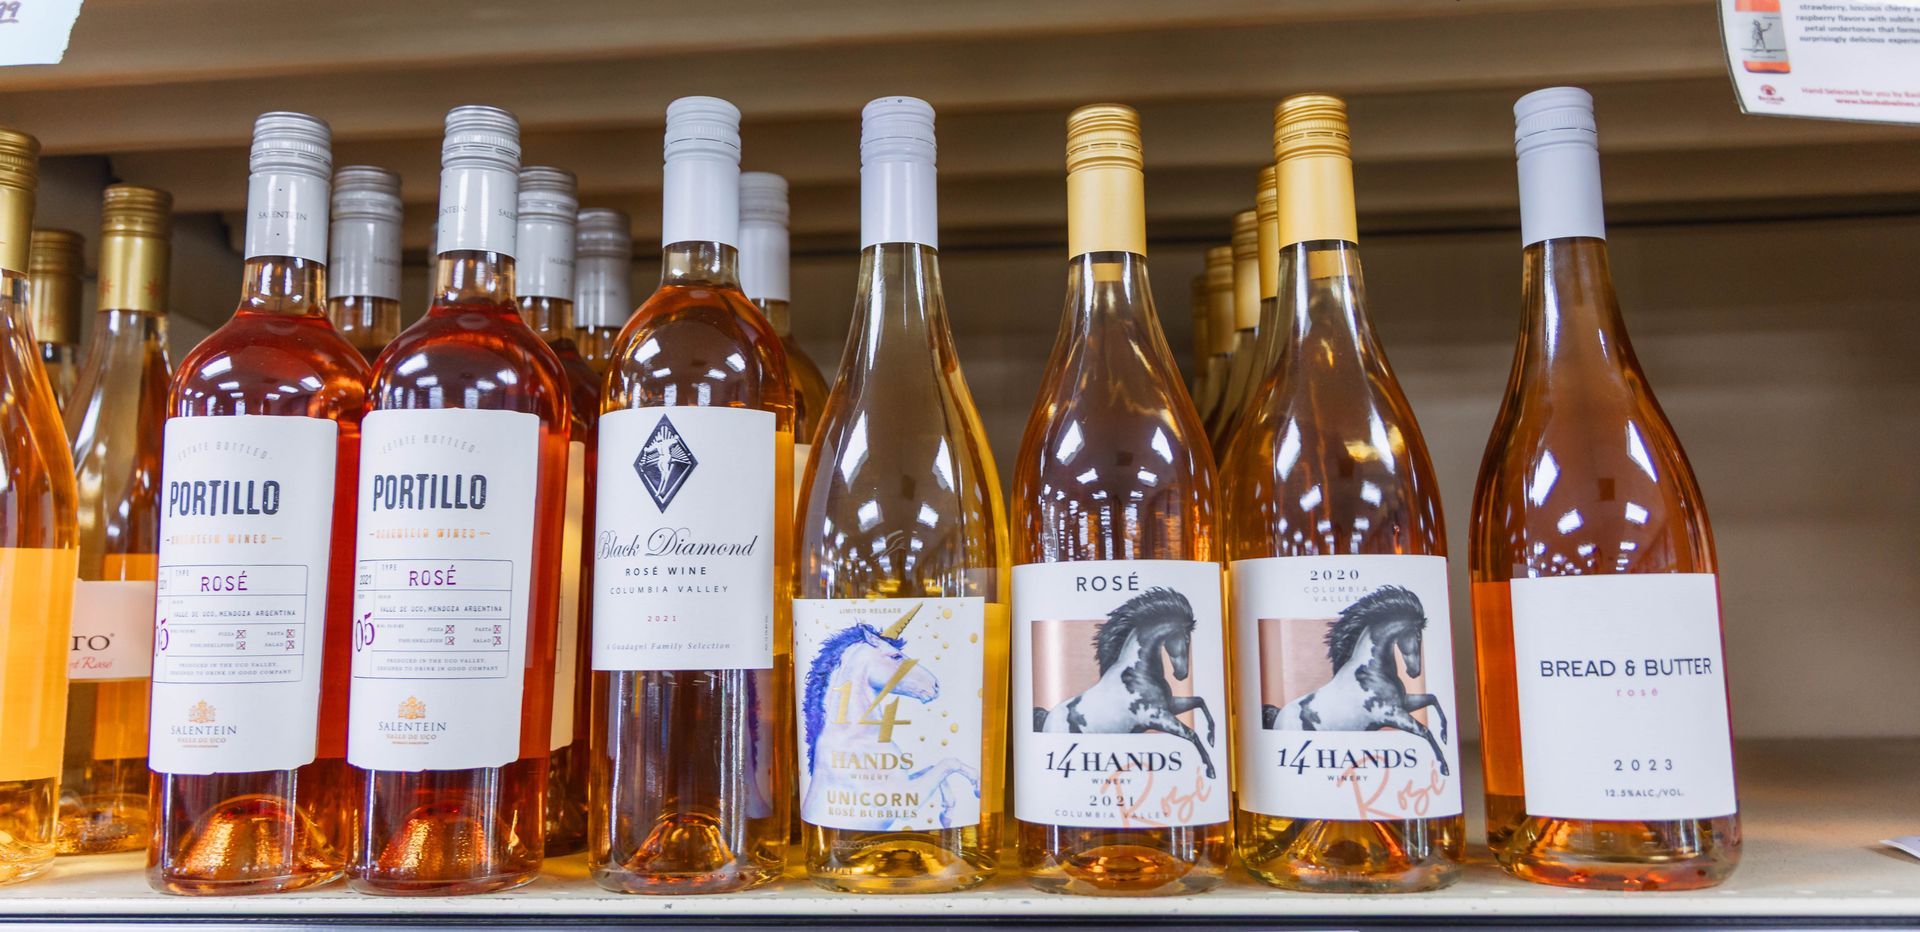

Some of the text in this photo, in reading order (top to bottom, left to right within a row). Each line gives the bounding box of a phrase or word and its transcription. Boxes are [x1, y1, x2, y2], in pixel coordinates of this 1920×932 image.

[372, 473, 488, 512] PORTILLO
[169, 480, 281, 518] PORTILLO
[597, 526, 759, 561] Black Diamond
[408, 564, 457, 586] ROSÉ
[625, 565, 708, 577] ROSÉ WINE
[1309, 569, 1360, 581] 2020
[201, 570, 249, 592] ROSÉ
[1076, 571, 1140, 592] ROSÉ
[609, 584, 730, 595] COLUMBIA VALLEY
[1304, 586, 1369, 594] COLUMBIA
[869, 607, 903, 615] RELEASE
[647, 615, 678, 623] 2021
[650, 642, 684, 652] Family
[687, 641, 731, 651] Selection
[1540, 657, 1712, 677] BREAD & BUTTER
[1616, 686, 1659, 697] rosé
[832, 658, 921, 744] 14
[170, 725, 238, 736] SALENTEIN
[377, 720, 448, 732] SALENTEIN
[830, 751, 915, 770] HANDS
[1045, 742, 1183, 779] 14 HANDS
[1277, 739, 1418, 775] 14 HANDS
[1613, 758, 1674, 771] 2023
[1091, 777, 1132, 785] WINERY
[1327, 774, 1369, 782] WINERY
[826, 790, 919, 807] UNICORN
[1088, 795, 1135, 807] 2021
[859, 807, 918, 819] BUBBLES
[1054, 809, 1116, 819] COLUMBIA
